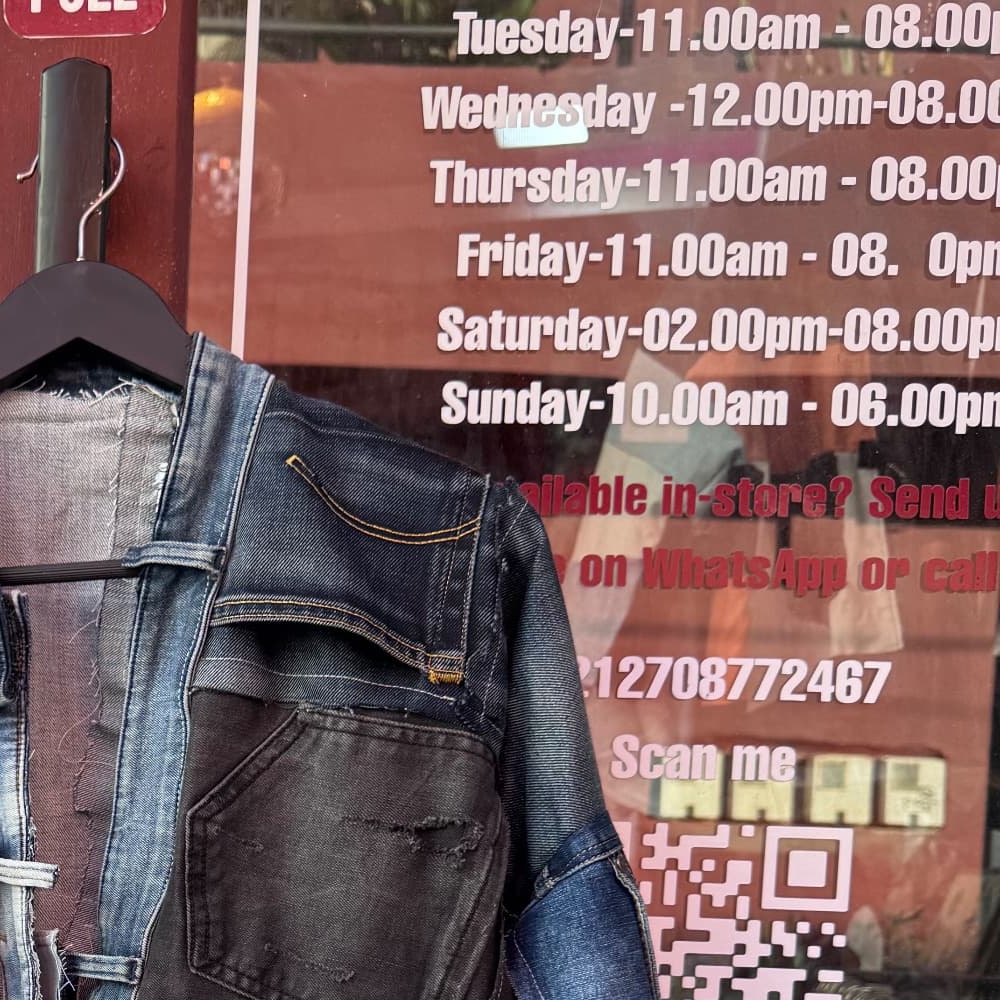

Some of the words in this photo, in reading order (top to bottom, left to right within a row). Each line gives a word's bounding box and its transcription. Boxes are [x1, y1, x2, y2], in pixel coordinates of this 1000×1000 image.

[453, 6, 820, 60] Tuesday-11.00am
[421, 84, 656, 134] Wednesday
[430, 157, 826, 209] Thursday-11.00am
[870, 155, 1000, 207] 08.00
[457, 232, 788, 284] Friday-11.00am
[437, 306, 1000, 358] Saturday-02.00pm-08.00p
[440, 381, 788, 432] Sunday-10.00am
[519, 474, 648, 517] ailable
[661, 475, 853, 518] in-store?
[869, 476, 970, 520] Send
[580, 553, 627, 588] on
[642, 547, 847, 598] WhatsApp
[861, 556, 910, 591] or
[924, 551, 998, 592] call
[610, 734, 718, 781] Scan
[731, 745, 797, 782] me
